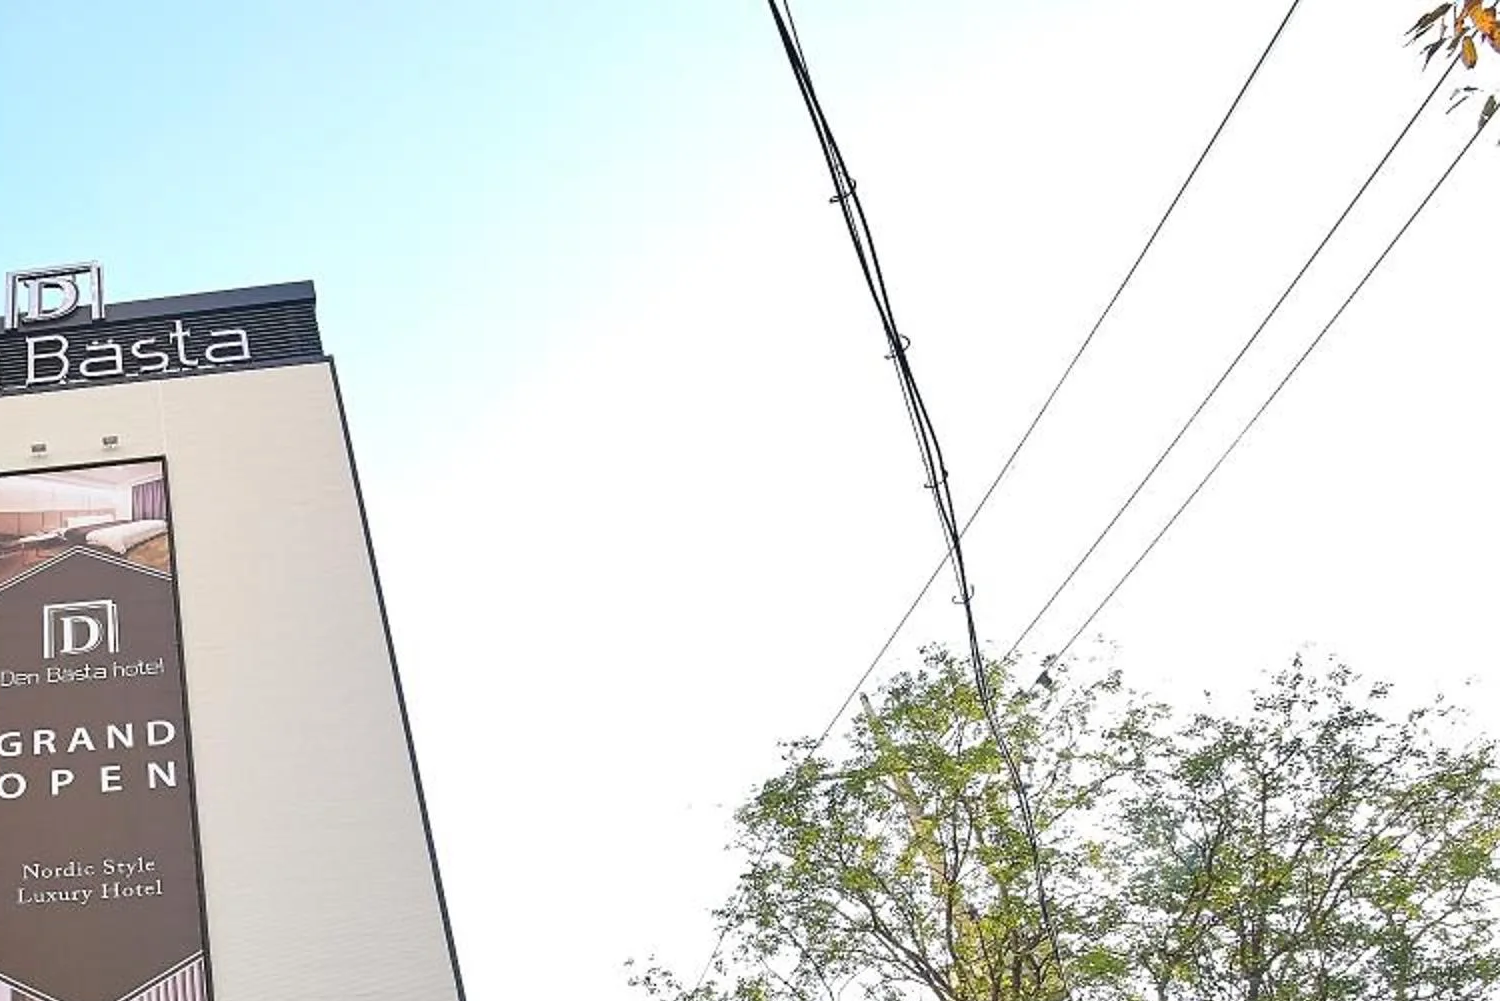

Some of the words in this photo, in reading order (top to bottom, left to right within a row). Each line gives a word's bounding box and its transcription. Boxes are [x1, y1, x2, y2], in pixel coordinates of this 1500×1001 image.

[0, 669, 40, 687] Den
[112, 657, 165, 678] hotel
[21, 860, 96, 881] Nordic
[102, 856, 156, 880] Style
[17, 886, 94, 906] Luxury
[100, 880, 164, 899] Hotel
